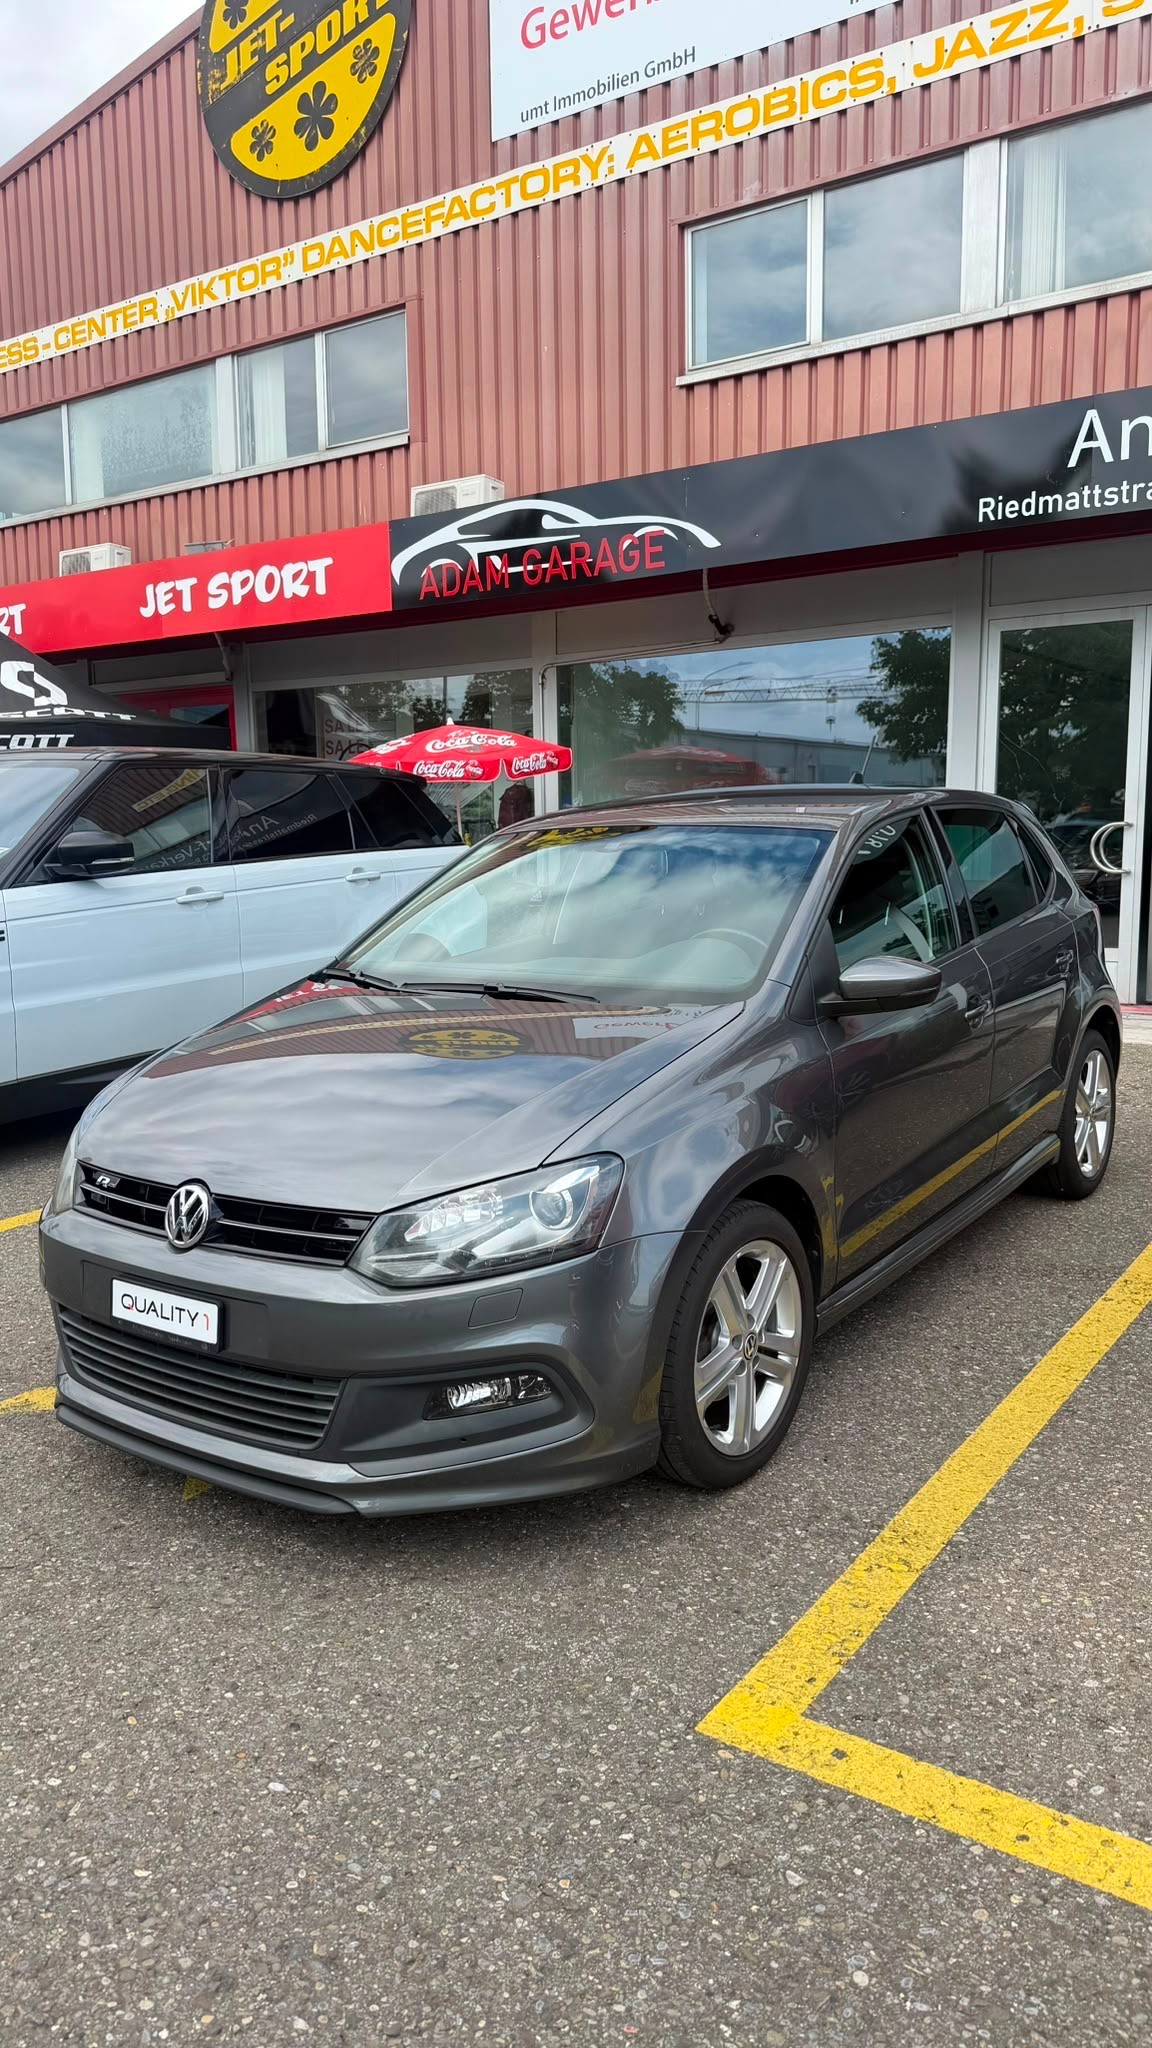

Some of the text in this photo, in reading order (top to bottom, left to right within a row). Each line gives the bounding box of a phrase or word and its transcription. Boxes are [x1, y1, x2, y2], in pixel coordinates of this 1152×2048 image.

[265, 0, 390, 95] SPOR
[520, 46, 697, 123] umt Immobilien GmbH
[301, 145, 616, 273] DANCEFACTORY:
[625, 57, 898, 170] AEROBICS,
[912, 0, 1085, 79] JAZZ,
[139, 556, 334, 618] JET SPORT
[418, 529, 667, 601] ADAM GARAGE
[121, 1293, 199, 1327] QUALITY
